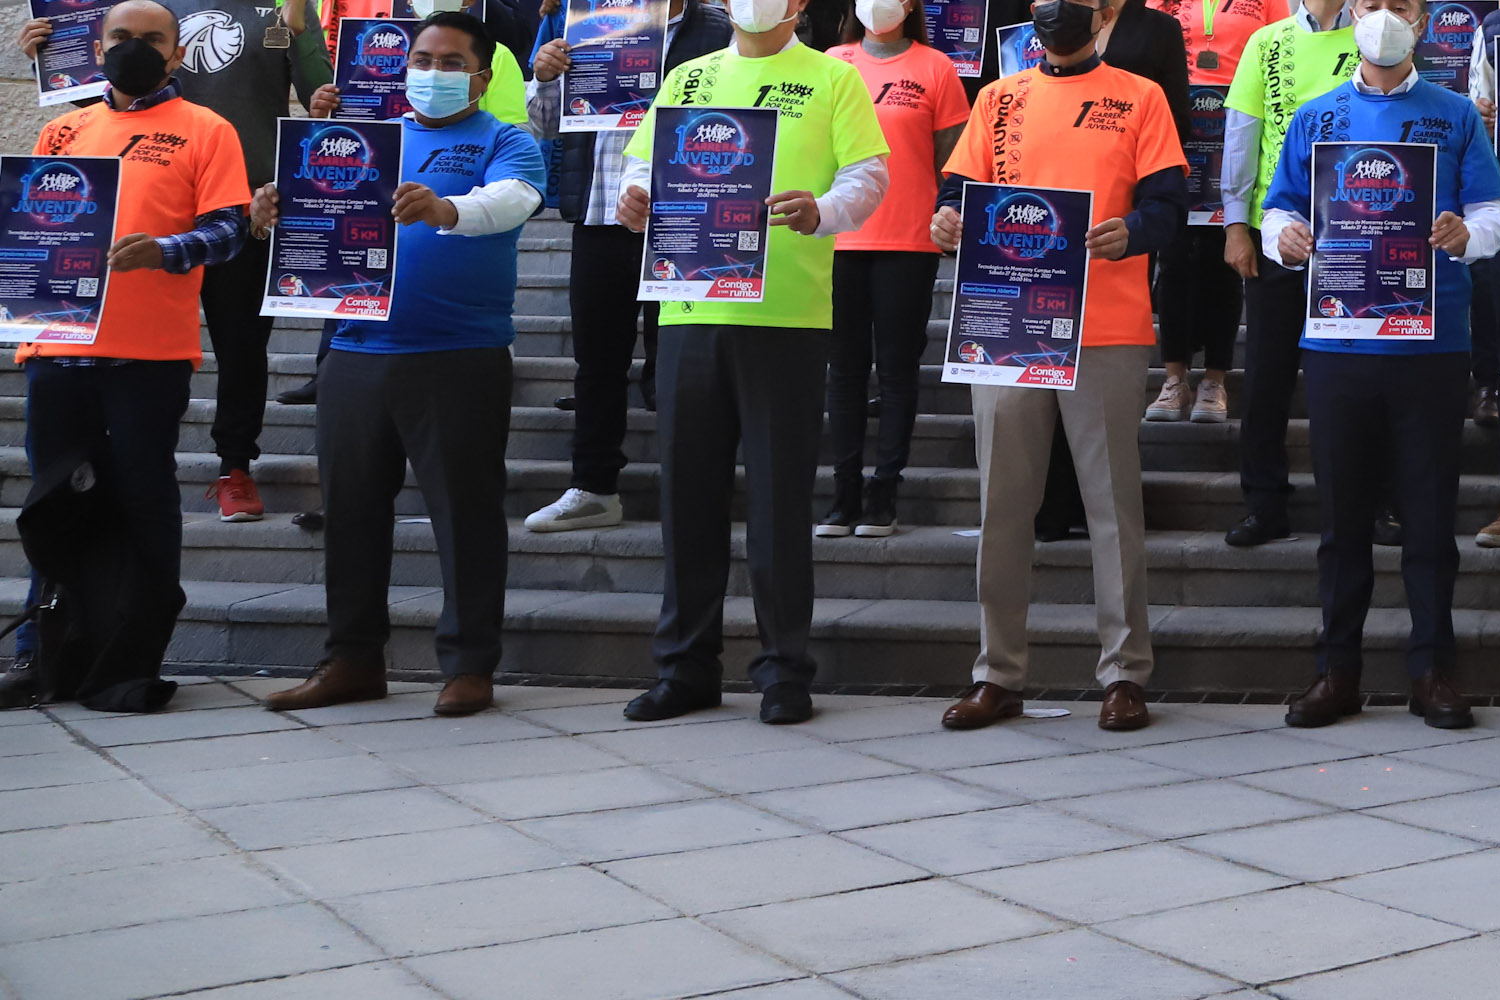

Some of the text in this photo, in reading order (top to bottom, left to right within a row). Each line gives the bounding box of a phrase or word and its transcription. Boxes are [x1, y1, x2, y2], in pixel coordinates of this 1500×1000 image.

[681, 68, 703, 105] MBO
[890, 91, 920, 99] CARRERA
[768, 96, 804, 106] CARRERA
[883, 101, 919, 109] JUVENTUD
[1092, 111, 1126, 119] CARRERA
[1085, 124, 1126, 133] JUVENTUD
[1413, 131, 1448, 140] CARRERA
[138, 144, 175, 154] CARRERA
[684, 142, 738, 152] CARRERA
[128, 155, 171, 166] JUVENTUD
[309, 156, 362, 166] CARRERA
[439, 155, 475, 164] CARRERA
[669, 152, 754, 166] JUVENTUD
[294, 166, 380, 181] JUVENTUD
[430, 167, 474, 176] JUVENTUD
[707, 166, 732, 174] 2022
[1345, 178, 1398, 188] CARRERA
[1330, 188, 1415, 202] JUVENTUD
[12, 200, 97, 214] JUVENTUD
[1369, 202, 1394, 211] 2022
[723, 211, 751, 223] 5 KM
[996, 222, 1049, 234] CARRERA
[351, 228, 378, 240] 5 KM
[978, 232, 1067, 250] JUVENTUD
[1020, 248, 1045, 258] 2022
[1389, 249, 1417, 260] 5 KM
[63, 259, 91, 270] 5 KM
[717, 280, 753, 292] Contigo
[729, 288, 759, 298] rumbo
[345, 297, 380, 310] Contigo
[1036, 297, 1066, 310] 5 KM
[357, 304, 386, 316] rumbo
[1388, 317, 1423, 329] Contigo
[50, 323, 86, 334] Contigo
[1401, 325, 1431, 334] rumbo
[61, 330, 91, 340] rumbo
[1030, 366, 1065, 380] Contigo
[1041, 375, 1072, 385] rumbo
